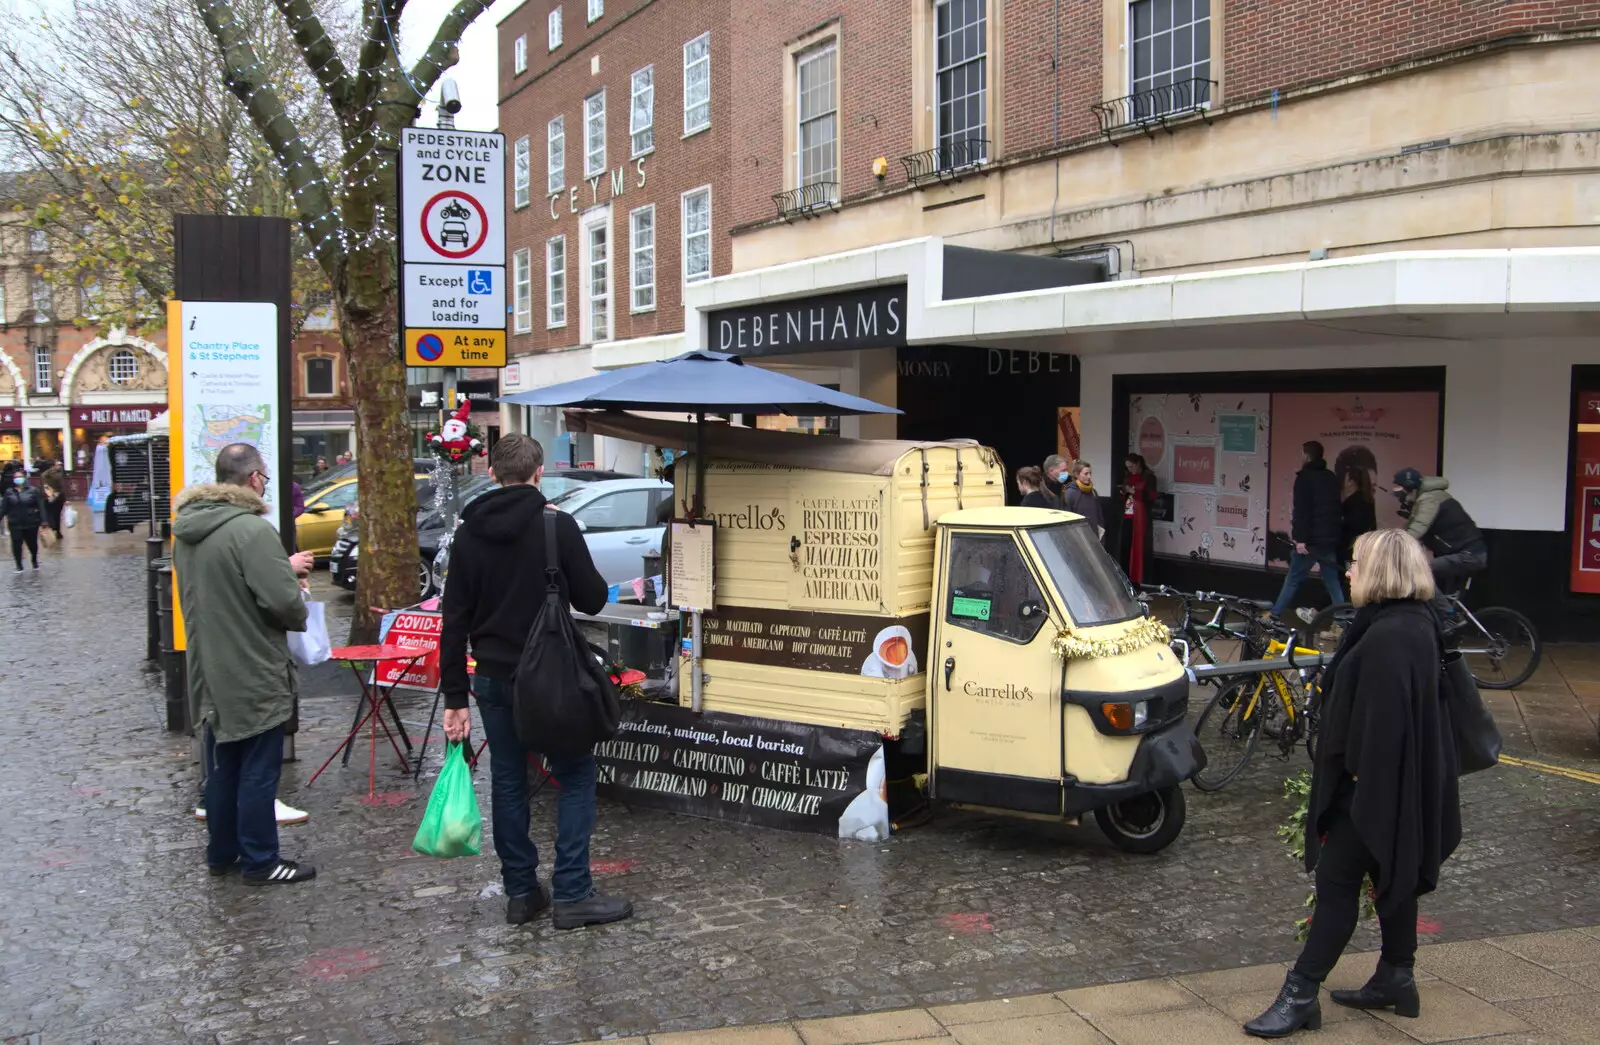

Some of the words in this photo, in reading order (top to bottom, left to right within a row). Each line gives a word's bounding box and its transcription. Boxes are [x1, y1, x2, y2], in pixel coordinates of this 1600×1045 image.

[408, 133, 499, 149] PEDESTRIAN
[417, 149, 440, 159] and
[445, 149, 491, 162] CYCLE
[422, 164, 486, 183] ZONE
[550, 157, 647, 220] CEYMS
[419, 275, 464, 288] Except
[432, 298, 456, 308] and
[460, 298, 479, 308] for
[432, 311, 479, 324] loading
[720, 297, 900, 350] DEBENHAMS
[189, 341, 229, 351] Chantry
[232, 341, 260, 350] Place
[454, 336, 468, 346] At
[473, 337, 495, 348] any
[189, 352, 197, 360] &
[199, 352, 210, 360] St
[212, 352, 260, 362] Stephens
[461, 349, 489, 360] time
[92, 410, 111, 423] PRET
[112, 410, 119, 422] A
[120, 409, 151, 422] MANGER
[1178, 456, 1210, 471] benefit
[704, 505, 786, 530] arrello's
[1217, 504, 1248, 517] tanning
[803, 510, 878, 531] RISTRETTO
[803, 531, 879, 547] ESPRESSO
[803, 546, 878, 568] MACCHIATO
[803, 567, 879, 581] CAPPUCCINO
[803, 580, 880, 602] AMERICANO
[395, 615, 443, 632] COVID-1
[726, 620, 763, 634] MACCHIATO
[770, 623, 811, 638] CAPPUCCINO
[818, 626, 841, 641] CAFFÈ
[842, 628, 867, 643] LATTÈ
[397, 635, 437, 650] Maintain
[710, 633, 733, 646] MOCHA
[742, 637, 784, 651] AMERICANO
[792, 641, 808, 654] HOT
[809, 643, 853, 658] CHOCOLATE
[963, 680, 1034, 702] Carrello's
[674, 727, 719, 746] unique,
[722, 730, 753, 748] local
[757, 735, 804, 755] barista
[673, 748, 745, 777] CAPPUCCINO
[761, 760, 801, 785] CAFFÈ
[805, 766, 850, 791] LATTÈ
[630, 769, 707, 797] AMERICANO
[721, 782, 749, 804] HOT
[751, 786, 822, 816] CHOCOLATE
